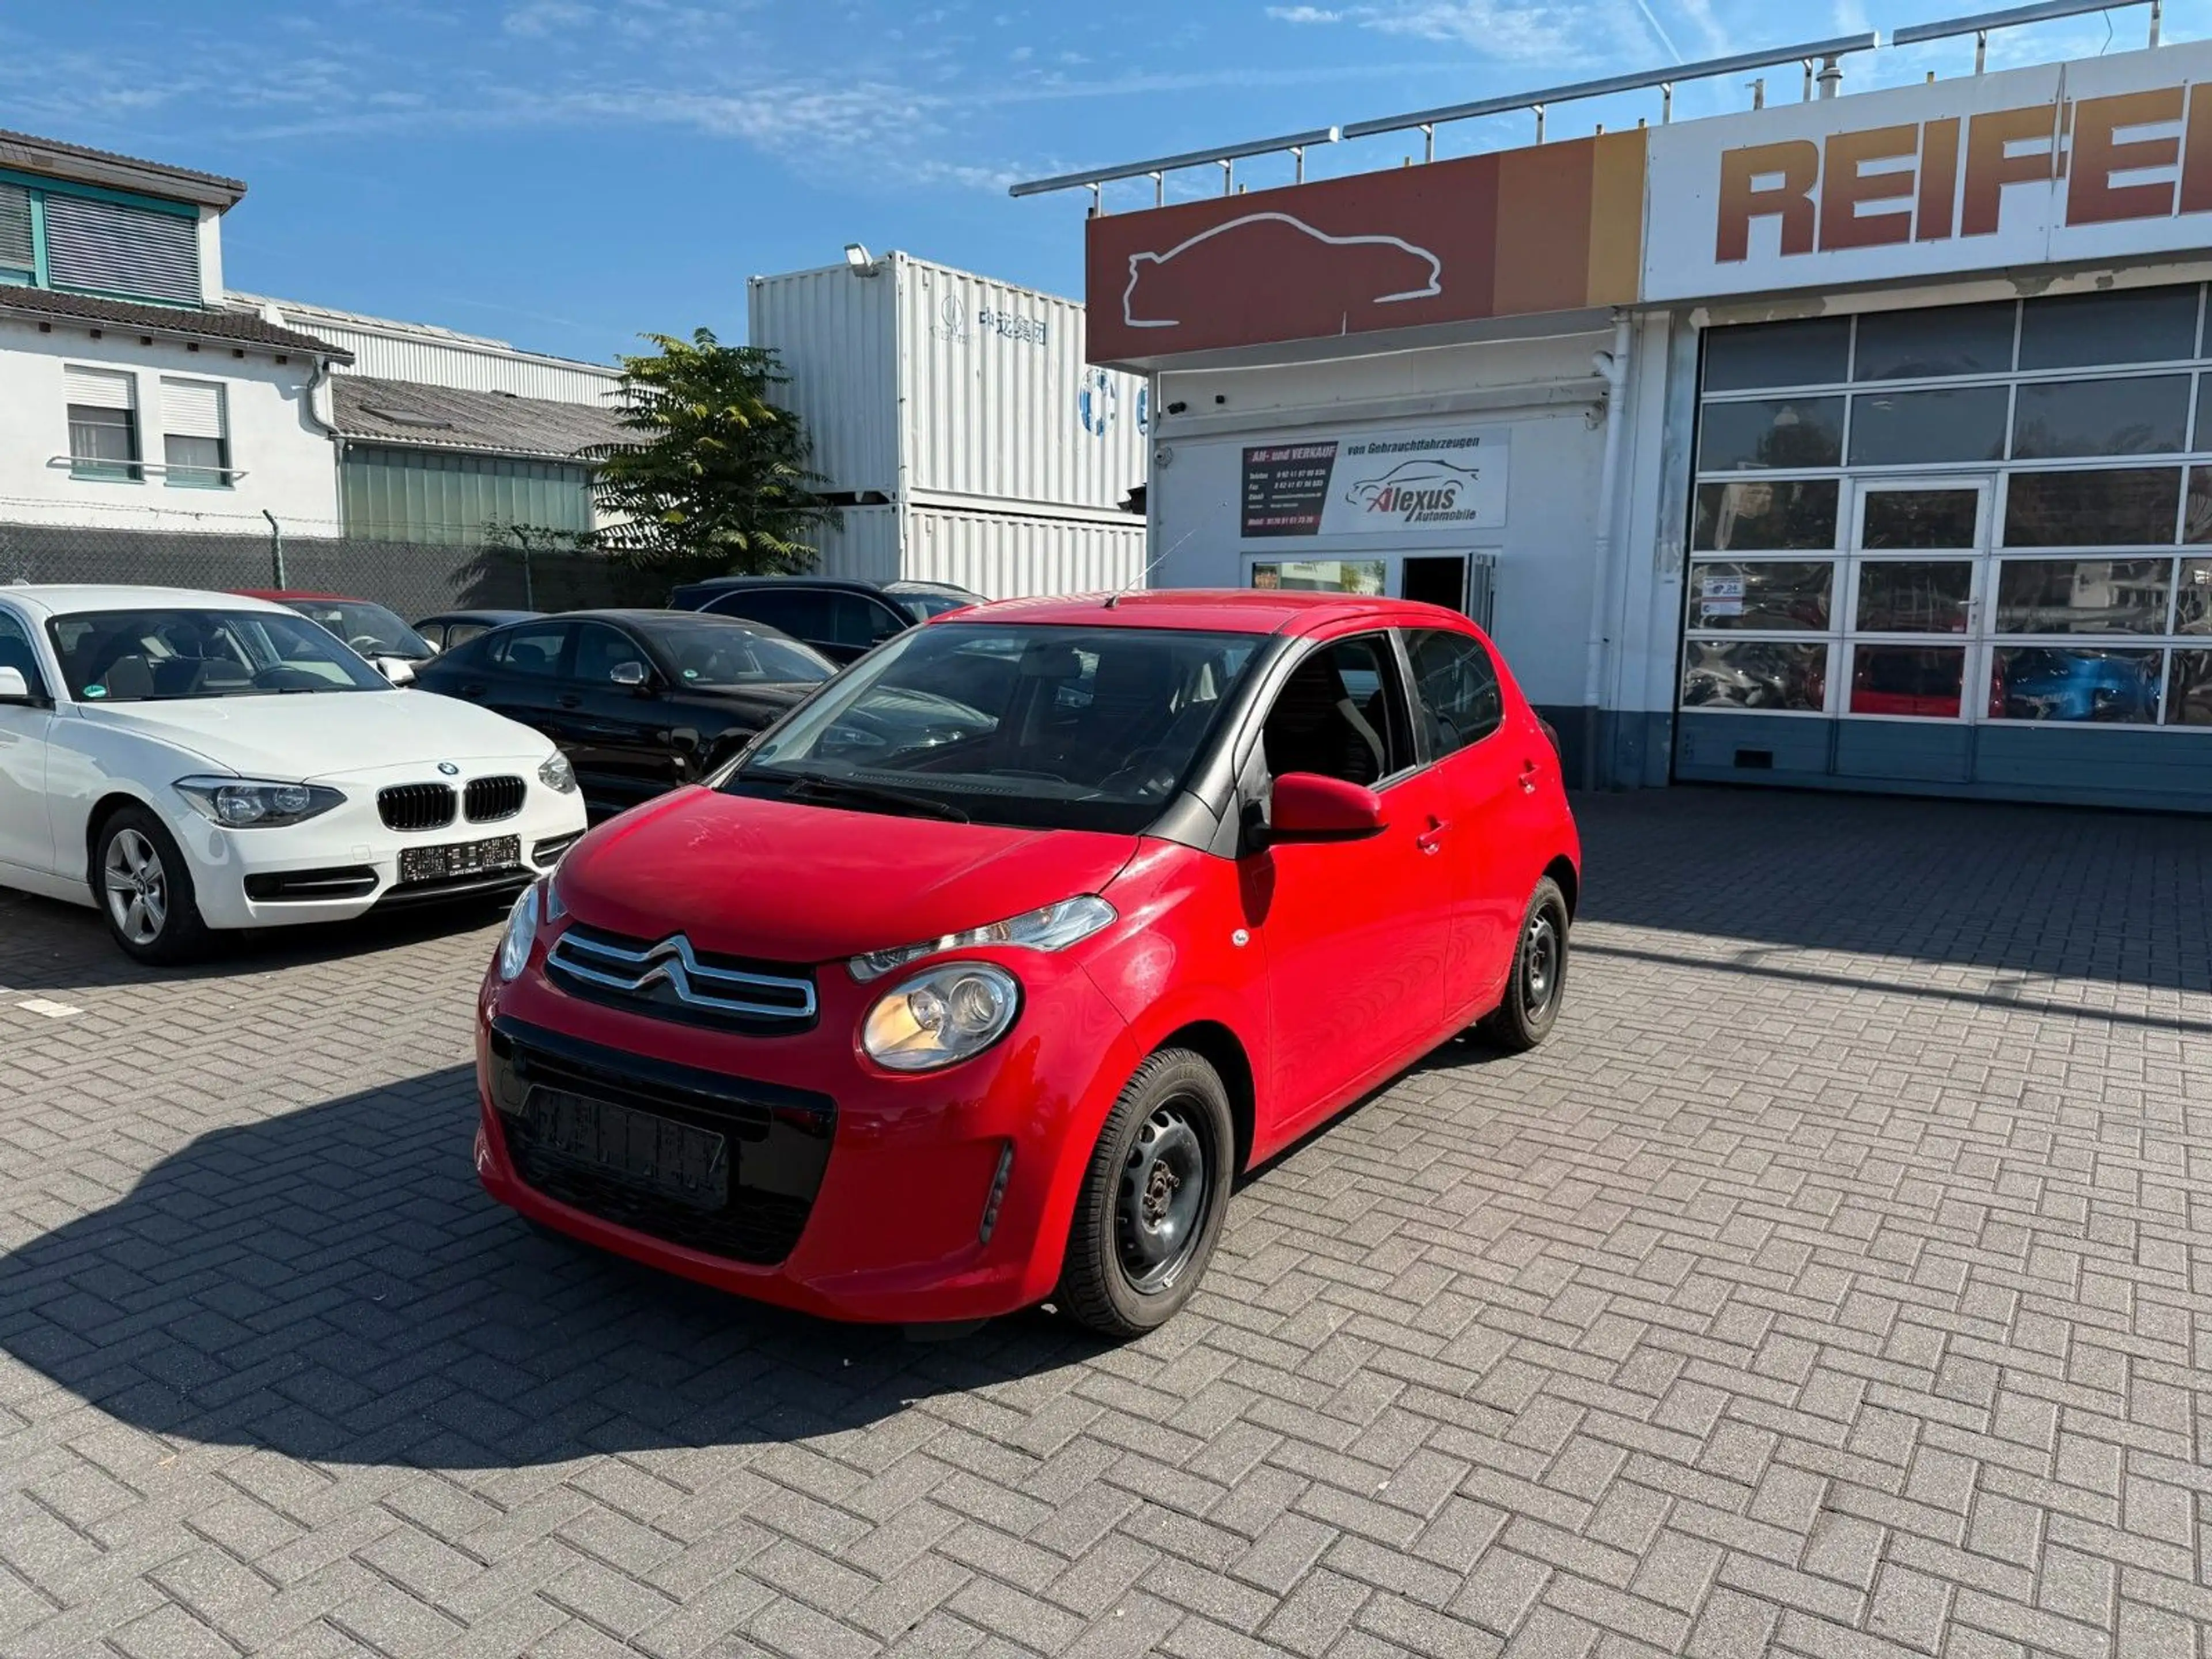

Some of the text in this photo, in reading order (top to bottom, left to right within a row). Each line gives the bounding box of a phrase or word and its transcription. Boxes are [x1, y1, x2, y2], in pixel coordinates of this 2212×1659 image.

[1715, 82, 2212, 265] REIFE
[1292, 446, 1337, 460] VERKAUF
[1348, 445, 1365, 455] von
[1368, 437, 1480, 454] Gebrauchtfahrzeugen
[1366, 487, 1456, 522] Alexus
[1414, 509, 1477, 522] Automobile
